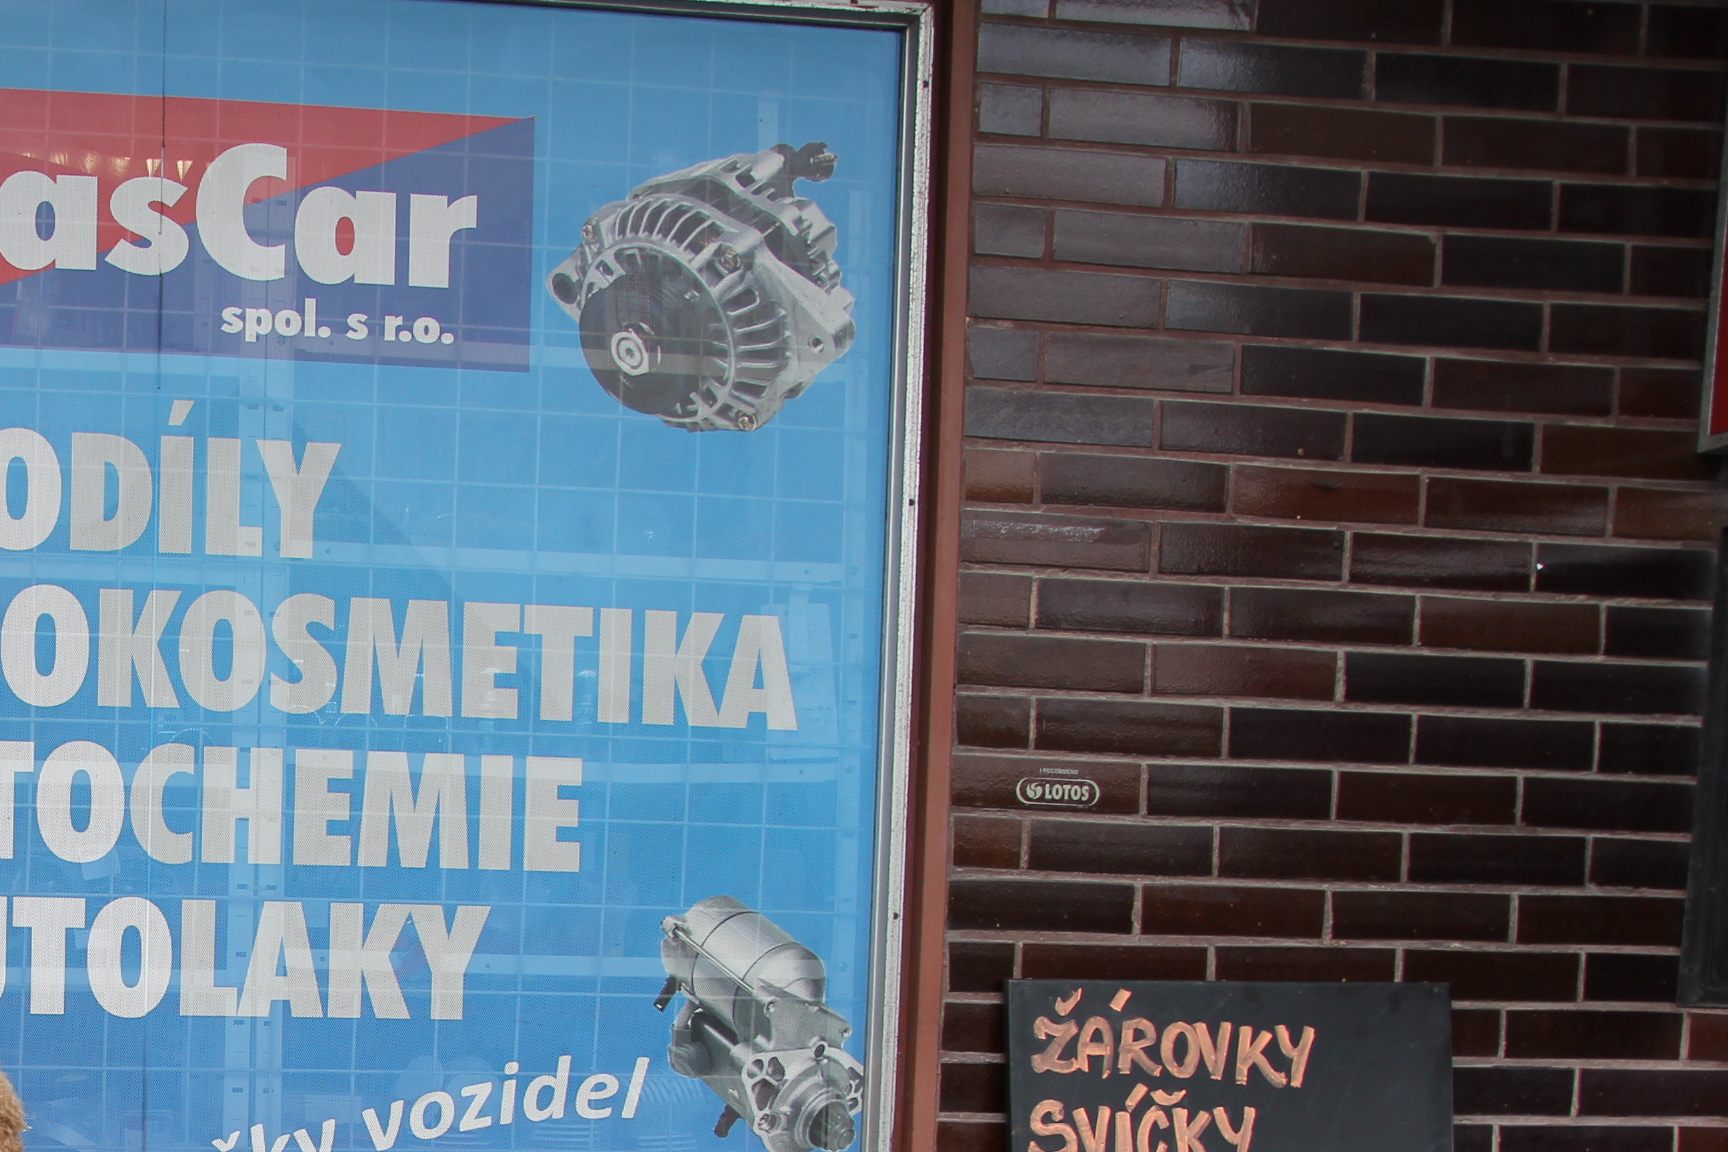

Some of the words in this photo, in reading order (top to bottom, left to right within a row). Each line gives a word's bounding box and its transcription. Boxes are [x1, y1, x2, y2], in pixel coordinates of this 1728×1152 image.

[220, 297, 331, 342] spol.
[345, 312, 369, 340] s
[385, 315, 454, 344] r.o.
[1044, 783, 1090, 801] LOTOS
[1030, 987, 1316, 1088] ŽÁROVKY
[362, 1055, 649, 1151] vozidel
